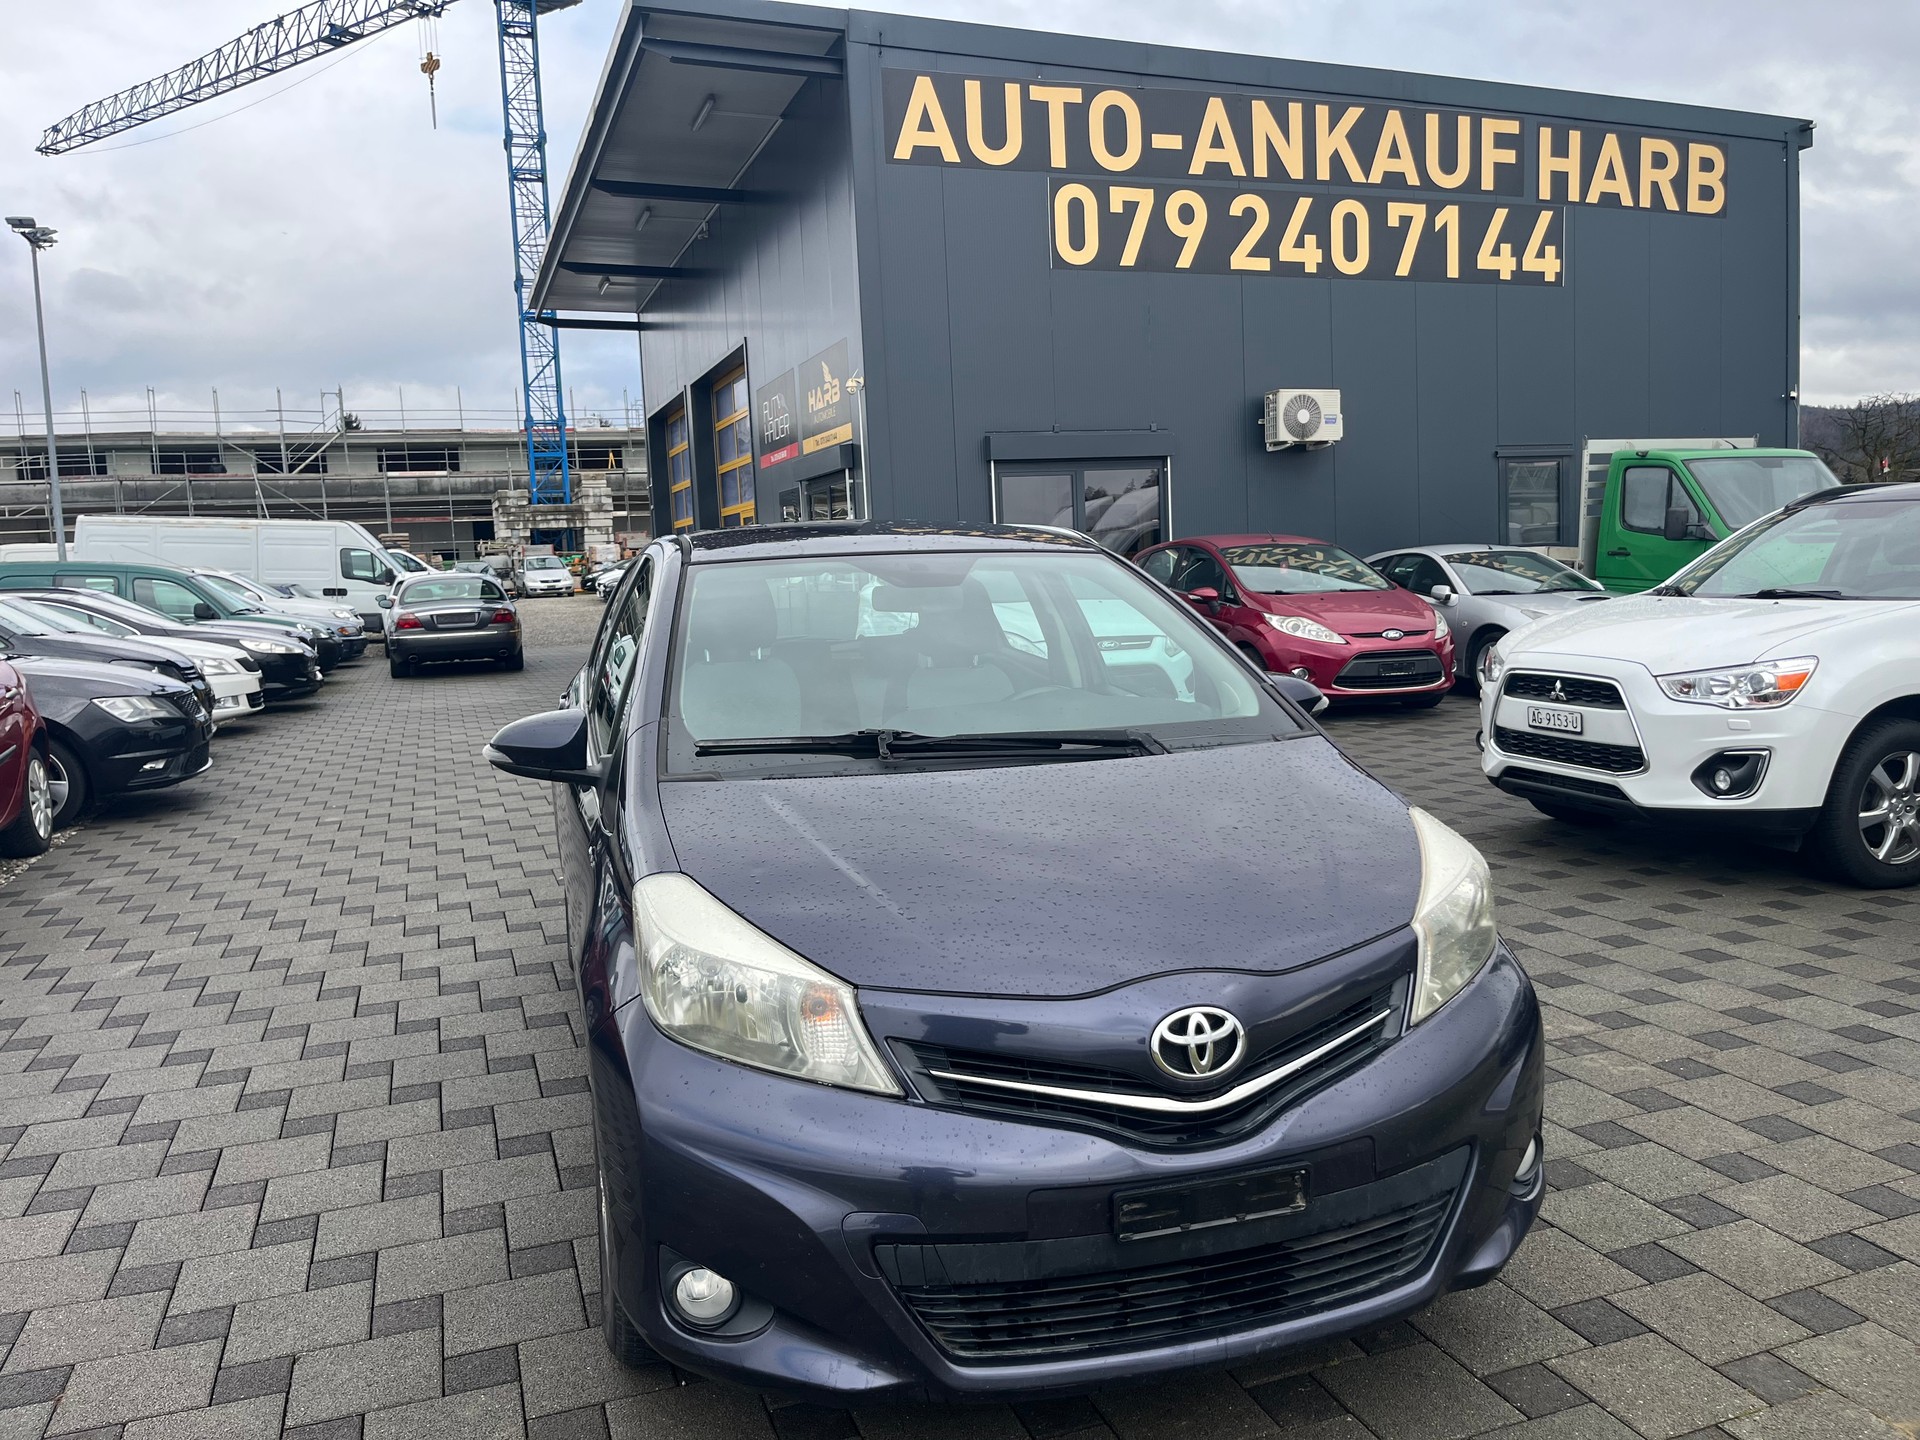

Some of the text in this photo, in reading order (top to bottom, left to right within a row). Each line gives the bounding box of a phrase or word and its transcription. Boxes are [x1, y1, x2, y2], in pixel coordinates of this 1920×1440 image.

[893, 75, 1726, 215] AUTO-ANKAUF HARB
[1053, 183, 1208, 269] 079
[1229, 193, 1370, 275] 240
[808, 378, 840, 413] HARB
